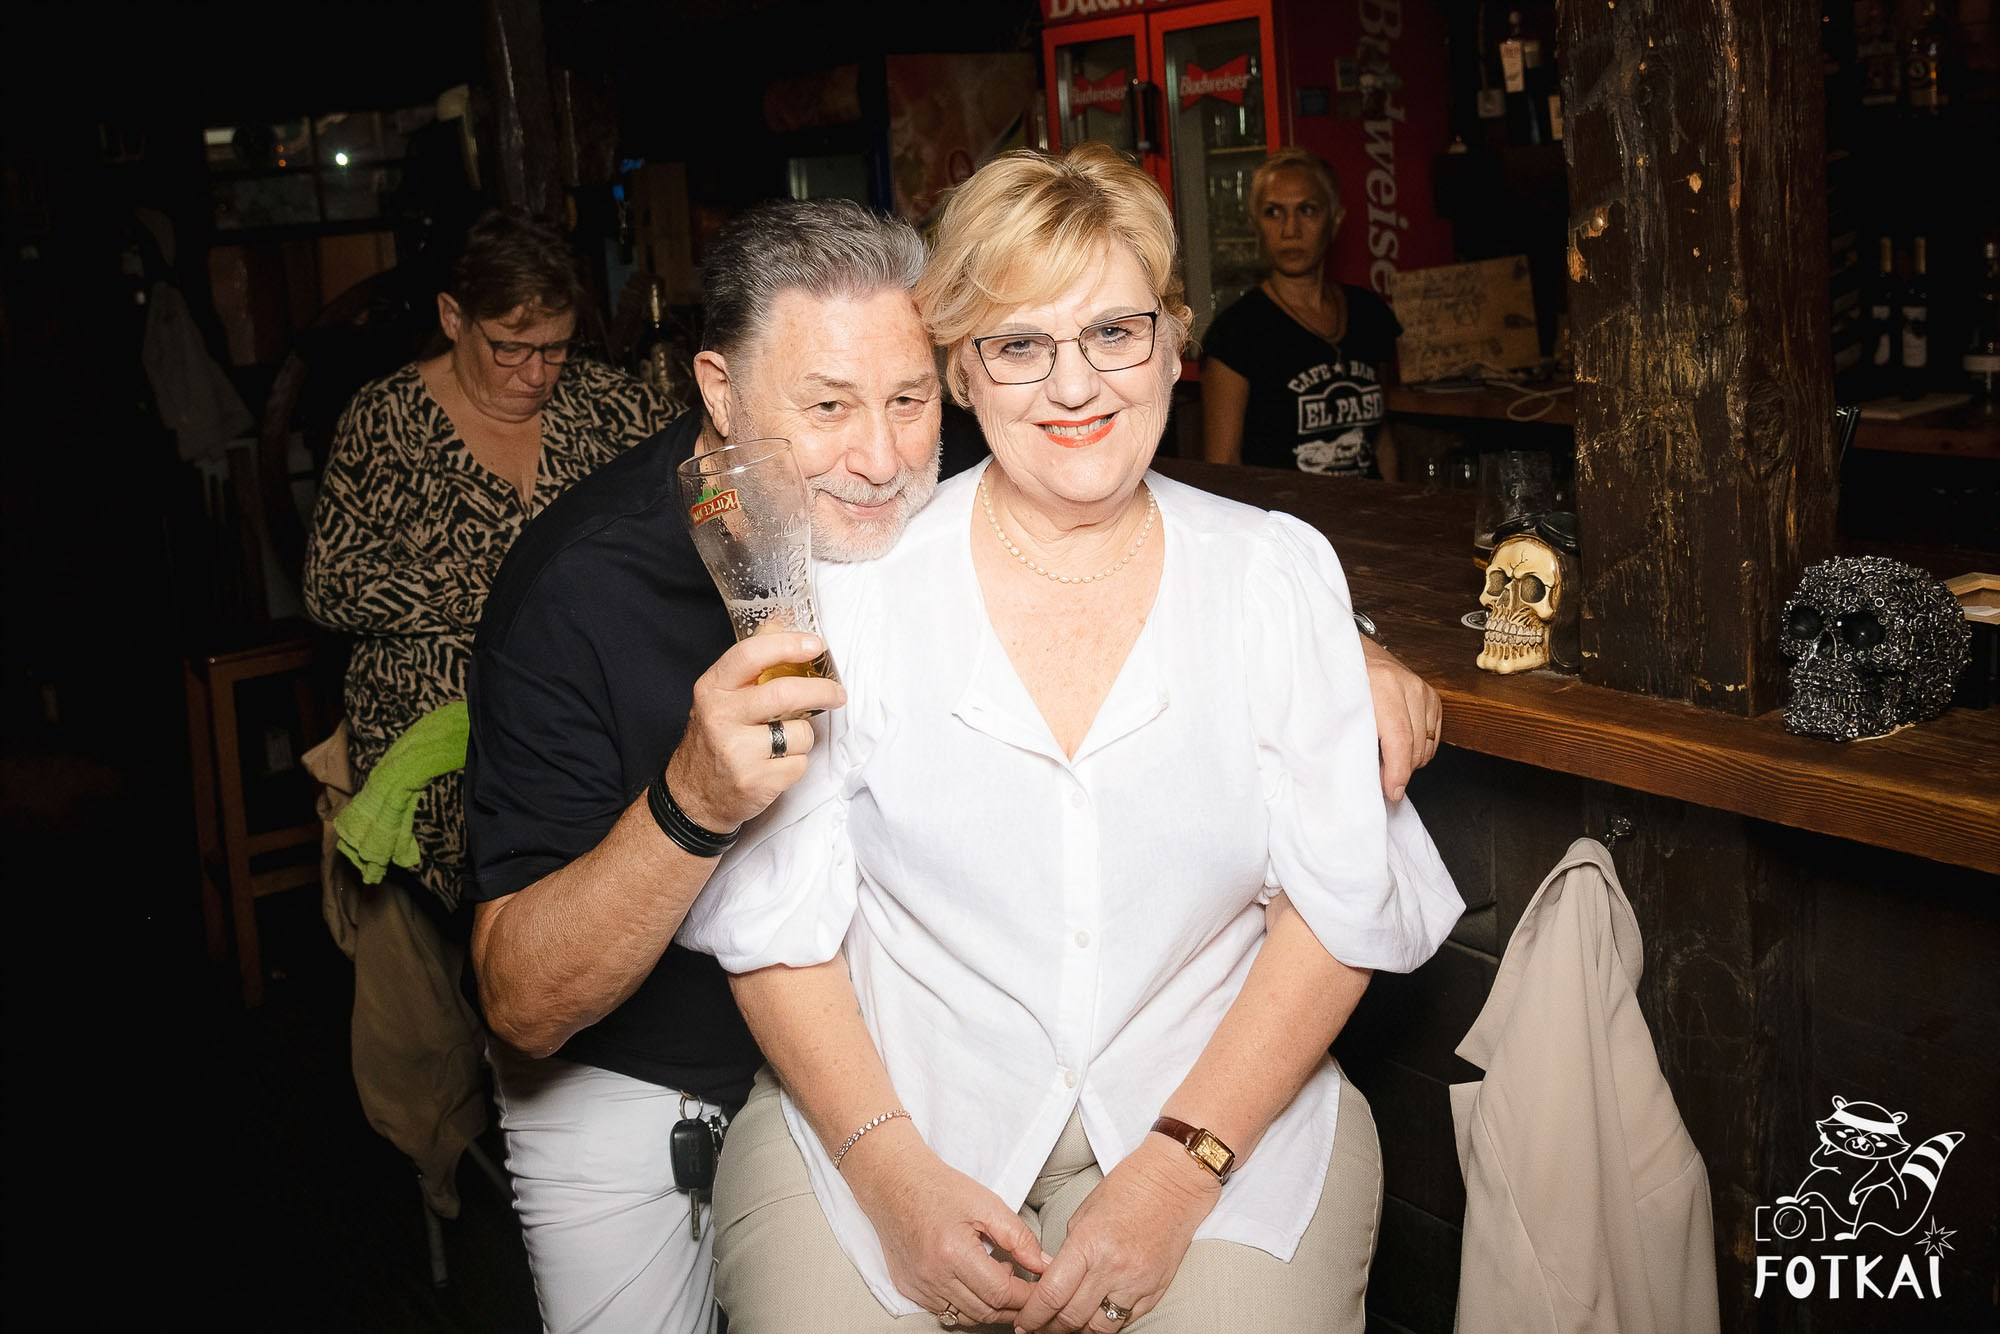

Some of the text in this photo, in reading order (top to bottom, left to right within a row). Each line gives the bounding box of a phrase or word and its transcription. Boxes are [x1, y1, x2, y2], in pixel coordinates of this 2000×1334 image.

[1070, 85, 1128, 105] Budweiser
[1179, 71, 1250, 96] Budweiser
[1287, 362, 1332, 393] CAFE
[1304, 401, 1332, 428] EL
